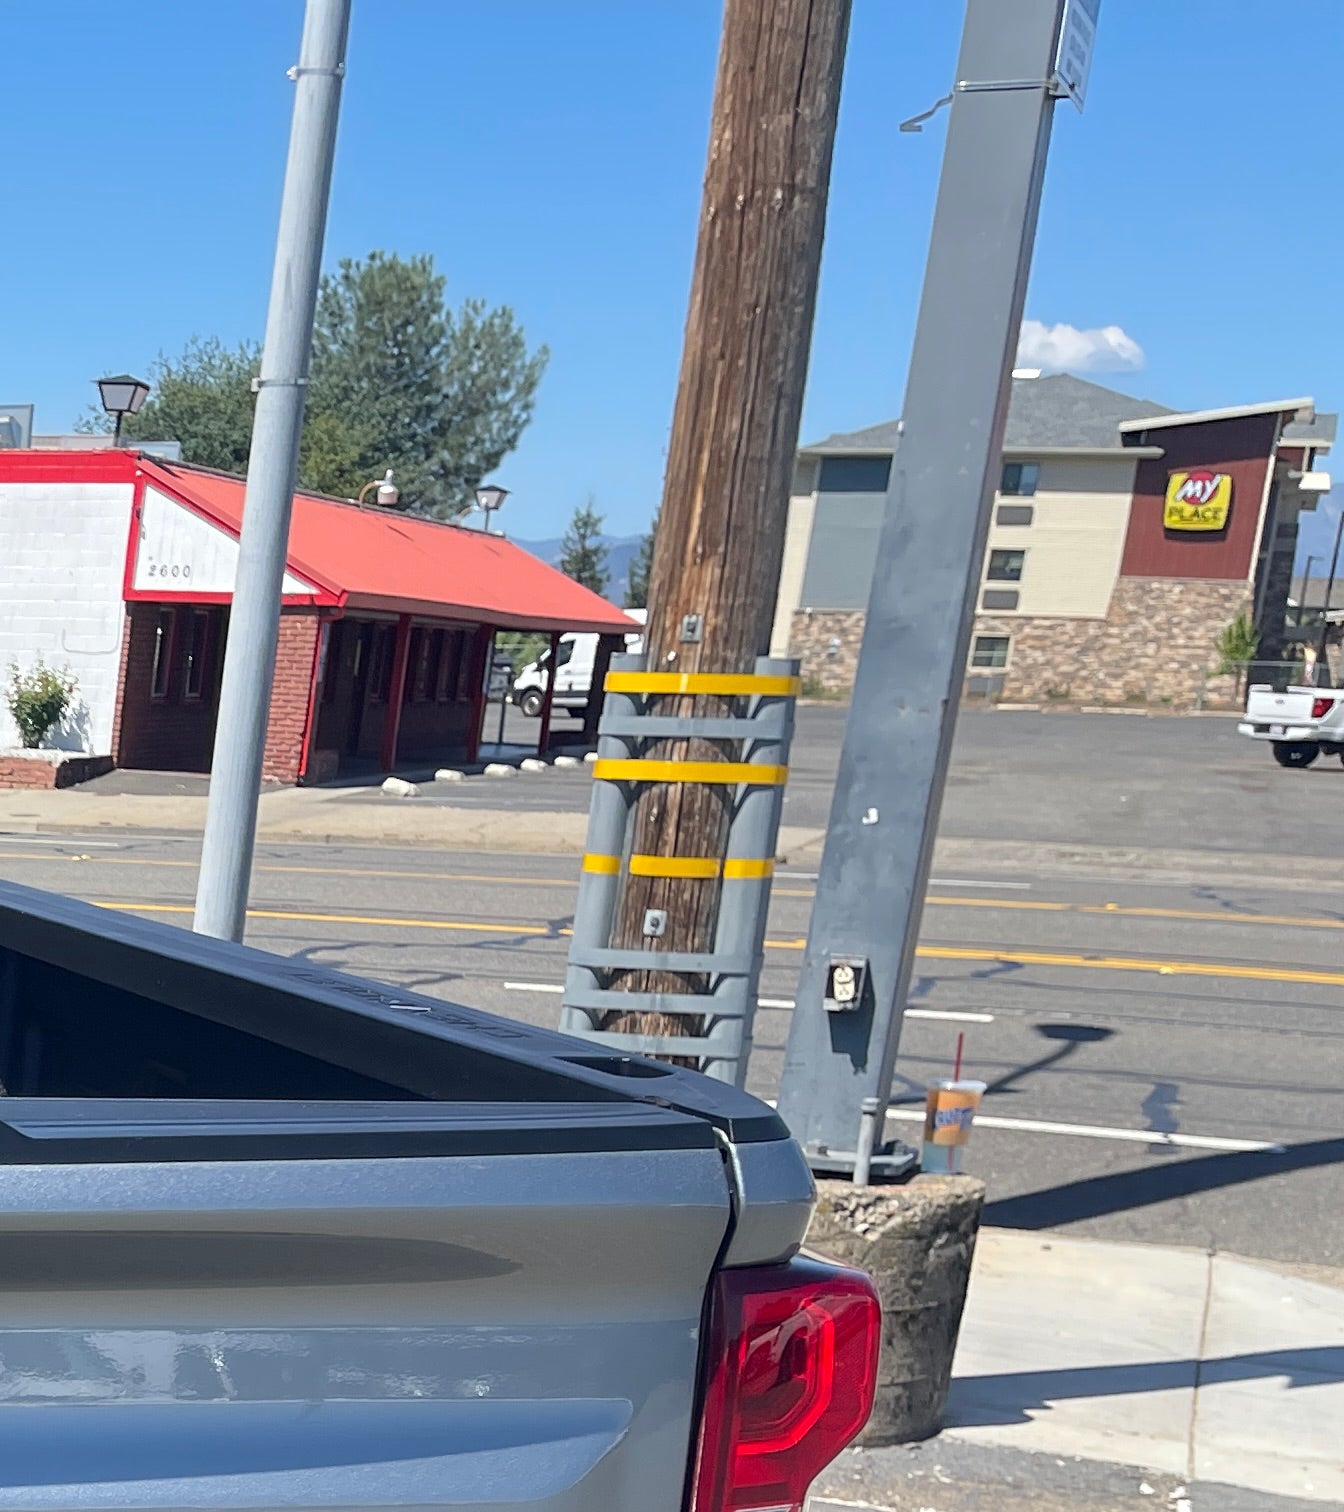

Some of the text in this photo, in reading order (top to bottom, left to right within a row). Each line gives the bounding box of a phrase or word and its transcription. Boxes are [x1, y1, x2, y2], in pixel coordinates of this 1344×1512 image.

[1173, 472, 1222, 504] MY
[1167, 505, 1223, 522] PLACE
[148, 564, 191, 579] 2600
